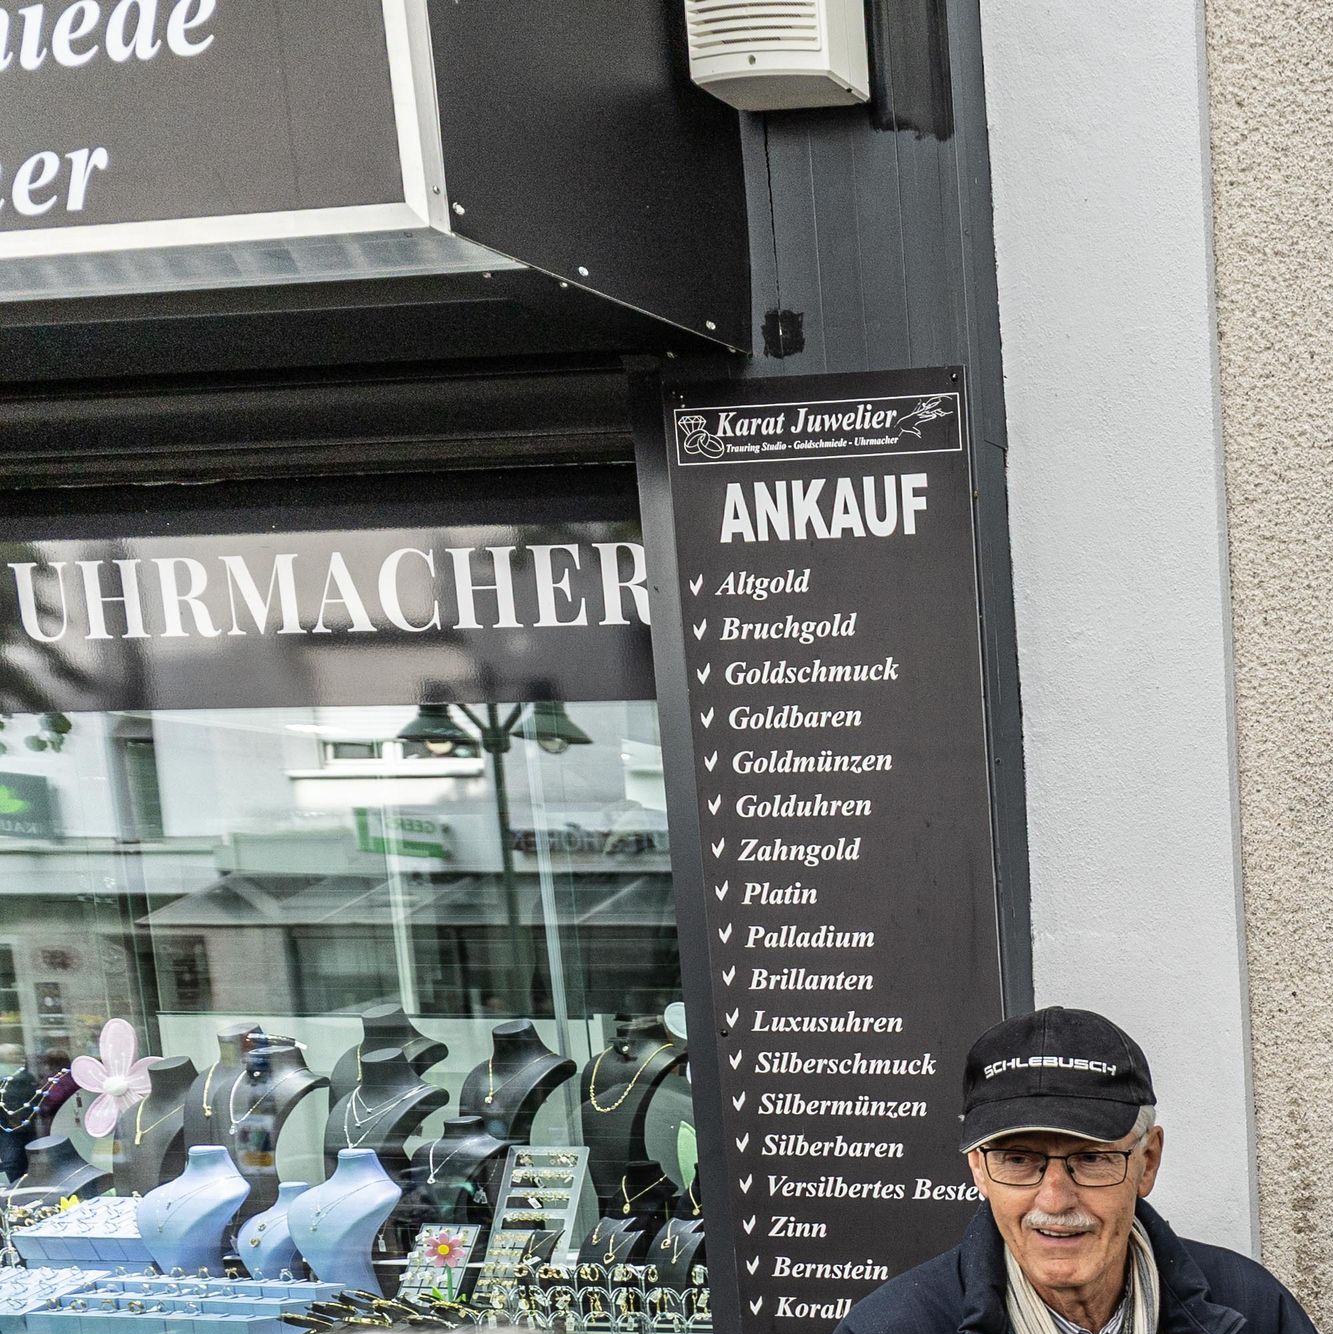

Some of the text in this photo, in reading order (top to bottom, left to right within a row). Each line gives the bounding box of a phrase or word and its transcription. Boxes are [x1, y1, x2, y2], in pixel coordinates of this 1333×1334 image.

[716, 404, 898, 438] Karat Juwelier
[726, 443, 760, 455] Trauring
[762, 441, 787, 452] Studio
[793, 438, 848, 450] Goldschmiede
[854, 435, 899, 447] Uhrmacher
[720, 473, 928, 543] ANKAUF
[7, 542, 652, 644] UHRMACHER
[715, 568, 811, 601] Altgold
[720, 612, 857, 645] Bruchgold
[725, 657, 899, 686] Goldschmuck
[728, 705, 862, 730] Goldbaren
[732, 750, 893, 775] Goldmünzen
[735, 794, 872, 818] Golduhren
[738, 838, 862, 867] Zahngold
[741, 882, 818, 905] Platin
[745, 925, 875, 949] Palladium
[748, 968, 874, 992] Brillanten
[751, 1010, 904, 1034] Luxusuhren
[755, 1051, 937, 1076] Silberschmuck
[984, 1056, 1116, 1079] SCHLEBUSCH
[758, 1092, 927, 1118] Silbermünzen
[762, 1134, 904, 1158] Silberbaren
[767, 1175, 906, 1200] Versilbertes
[768, 1216, 827, 1238] Zinn
[772, 1256, 889, 1281] Bernstein
